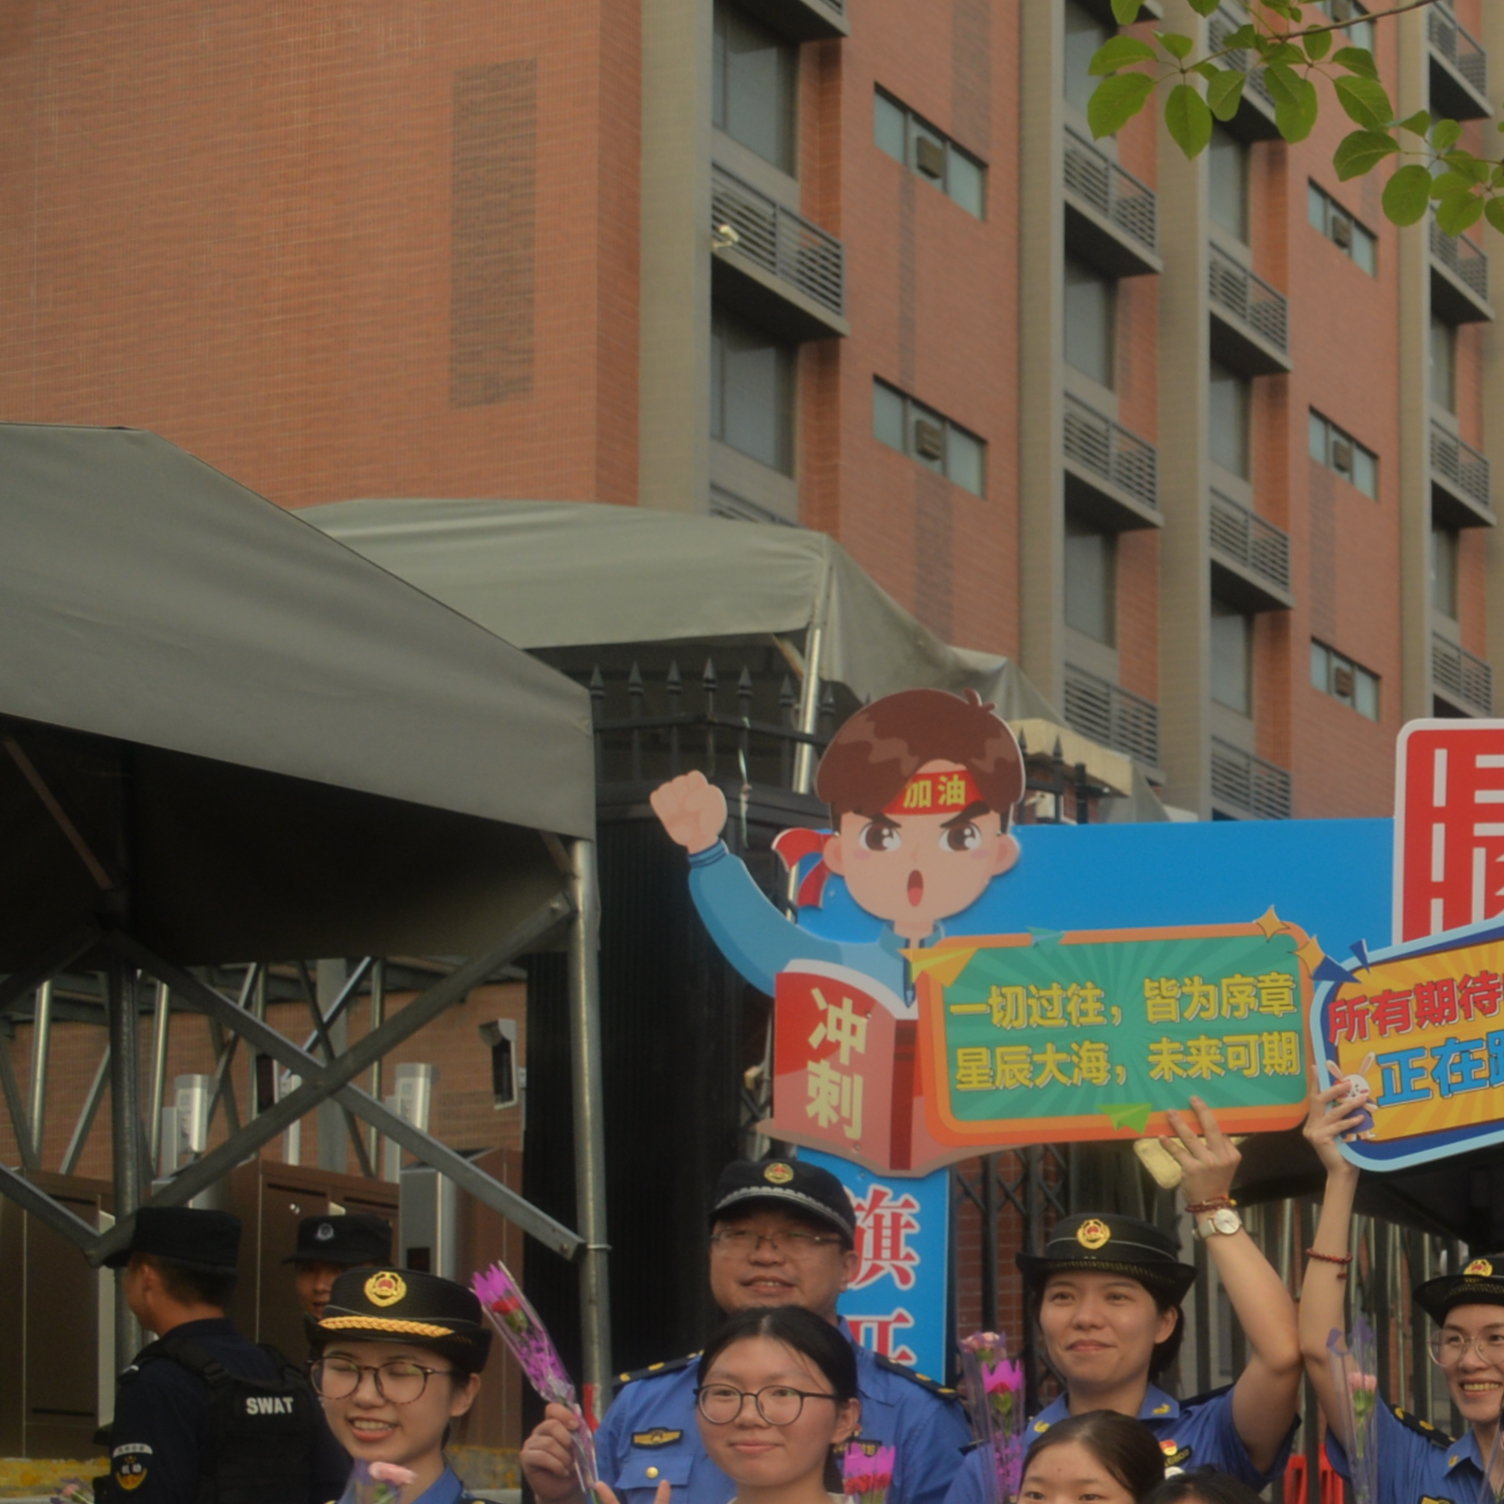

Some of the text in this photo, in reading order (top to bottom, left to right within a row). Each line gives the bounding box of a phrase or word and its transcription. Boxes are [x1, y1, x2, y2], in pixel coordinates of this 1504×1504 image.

[903, 774, 967, 809] 加油
[806, 986, 869, 1141] 冲刺
[246, 1397, 294, 1414] SWAT
